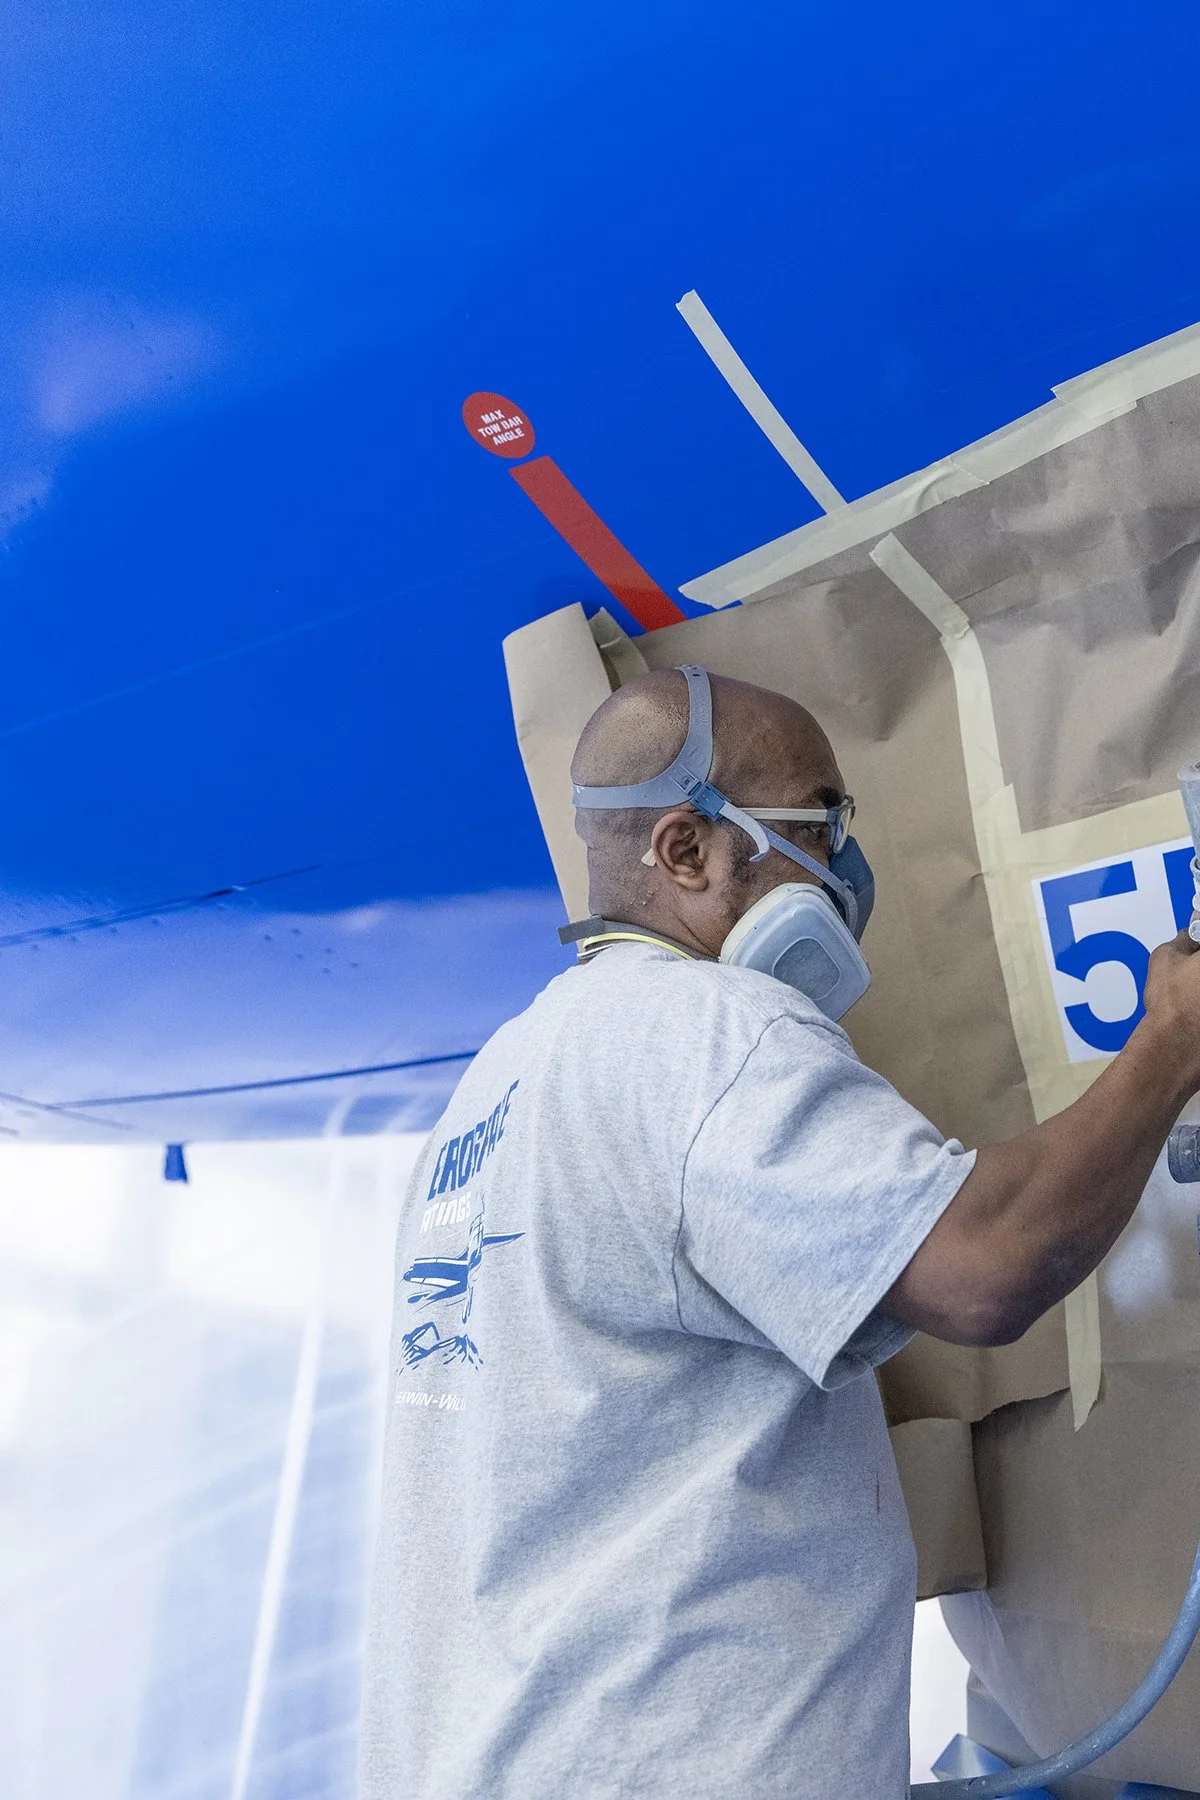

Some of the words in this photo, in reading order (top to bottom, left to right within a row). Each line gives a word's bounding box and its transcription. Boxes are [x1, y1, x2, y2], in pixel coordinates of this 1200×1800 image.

[481, 410, 504, 424] MAX
[478, 423, 501, 437] TOW
[501, 416, 523, 430] BAR
[493, 428, 524, 445] ANGLE
